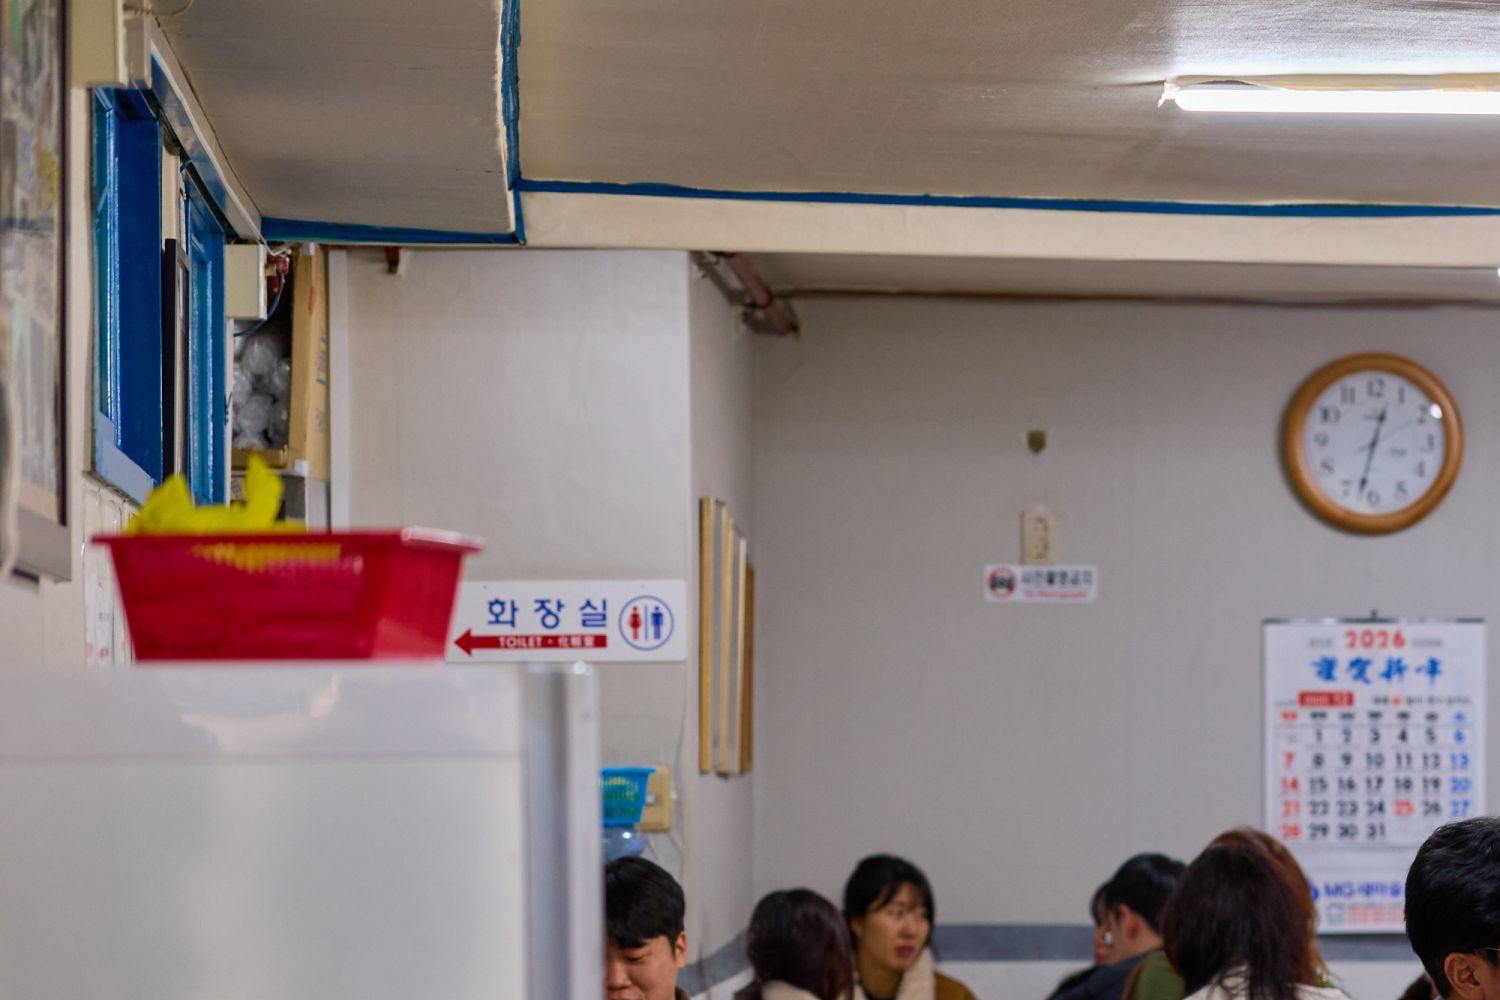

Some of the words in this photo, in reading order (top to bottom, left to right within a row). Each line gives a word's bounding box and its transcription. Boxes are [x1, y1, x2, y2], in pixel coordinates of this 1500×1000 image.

[487, 598, 608, 629] 화장실
[499, 636, 542, 649] TOILET
[1345, 629, 1405, 650] 2026
[1315, 728, 1323, 745] 1
[1370, 727, 1382, 745] 3
[1397, 728, 1409, 745] 4
[1453, 728, 1466, 745] 6
[1284, 752, 1296, 770] 7
